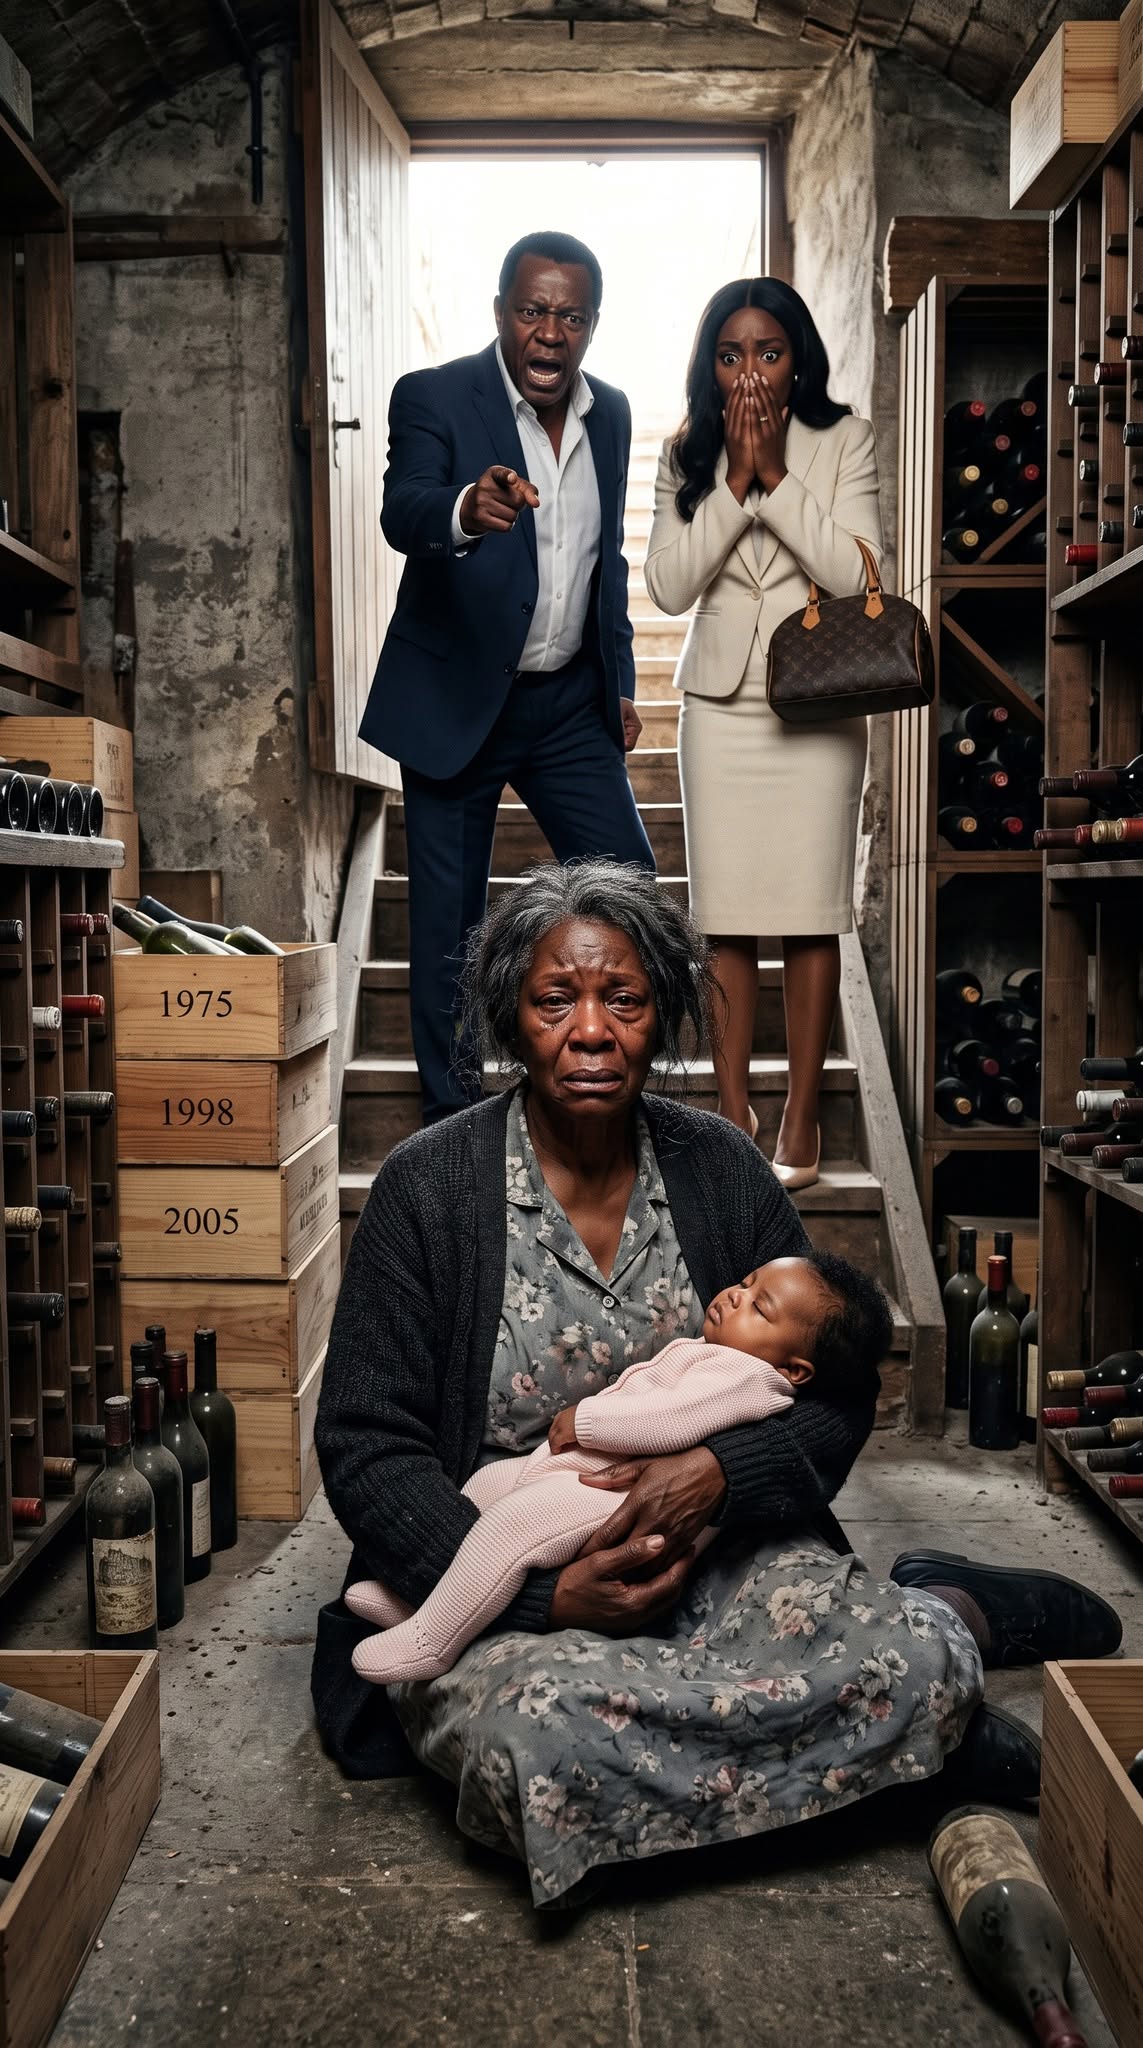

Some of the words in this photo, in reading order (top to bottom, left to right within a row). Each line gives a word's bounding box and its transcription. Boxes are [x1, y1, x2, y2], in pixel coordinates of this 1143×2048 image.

[160, 989, 233, 1018] 1975
[161, 1097, 234, 1126] 1998
[164, 1207, 239, 1235] 2005
